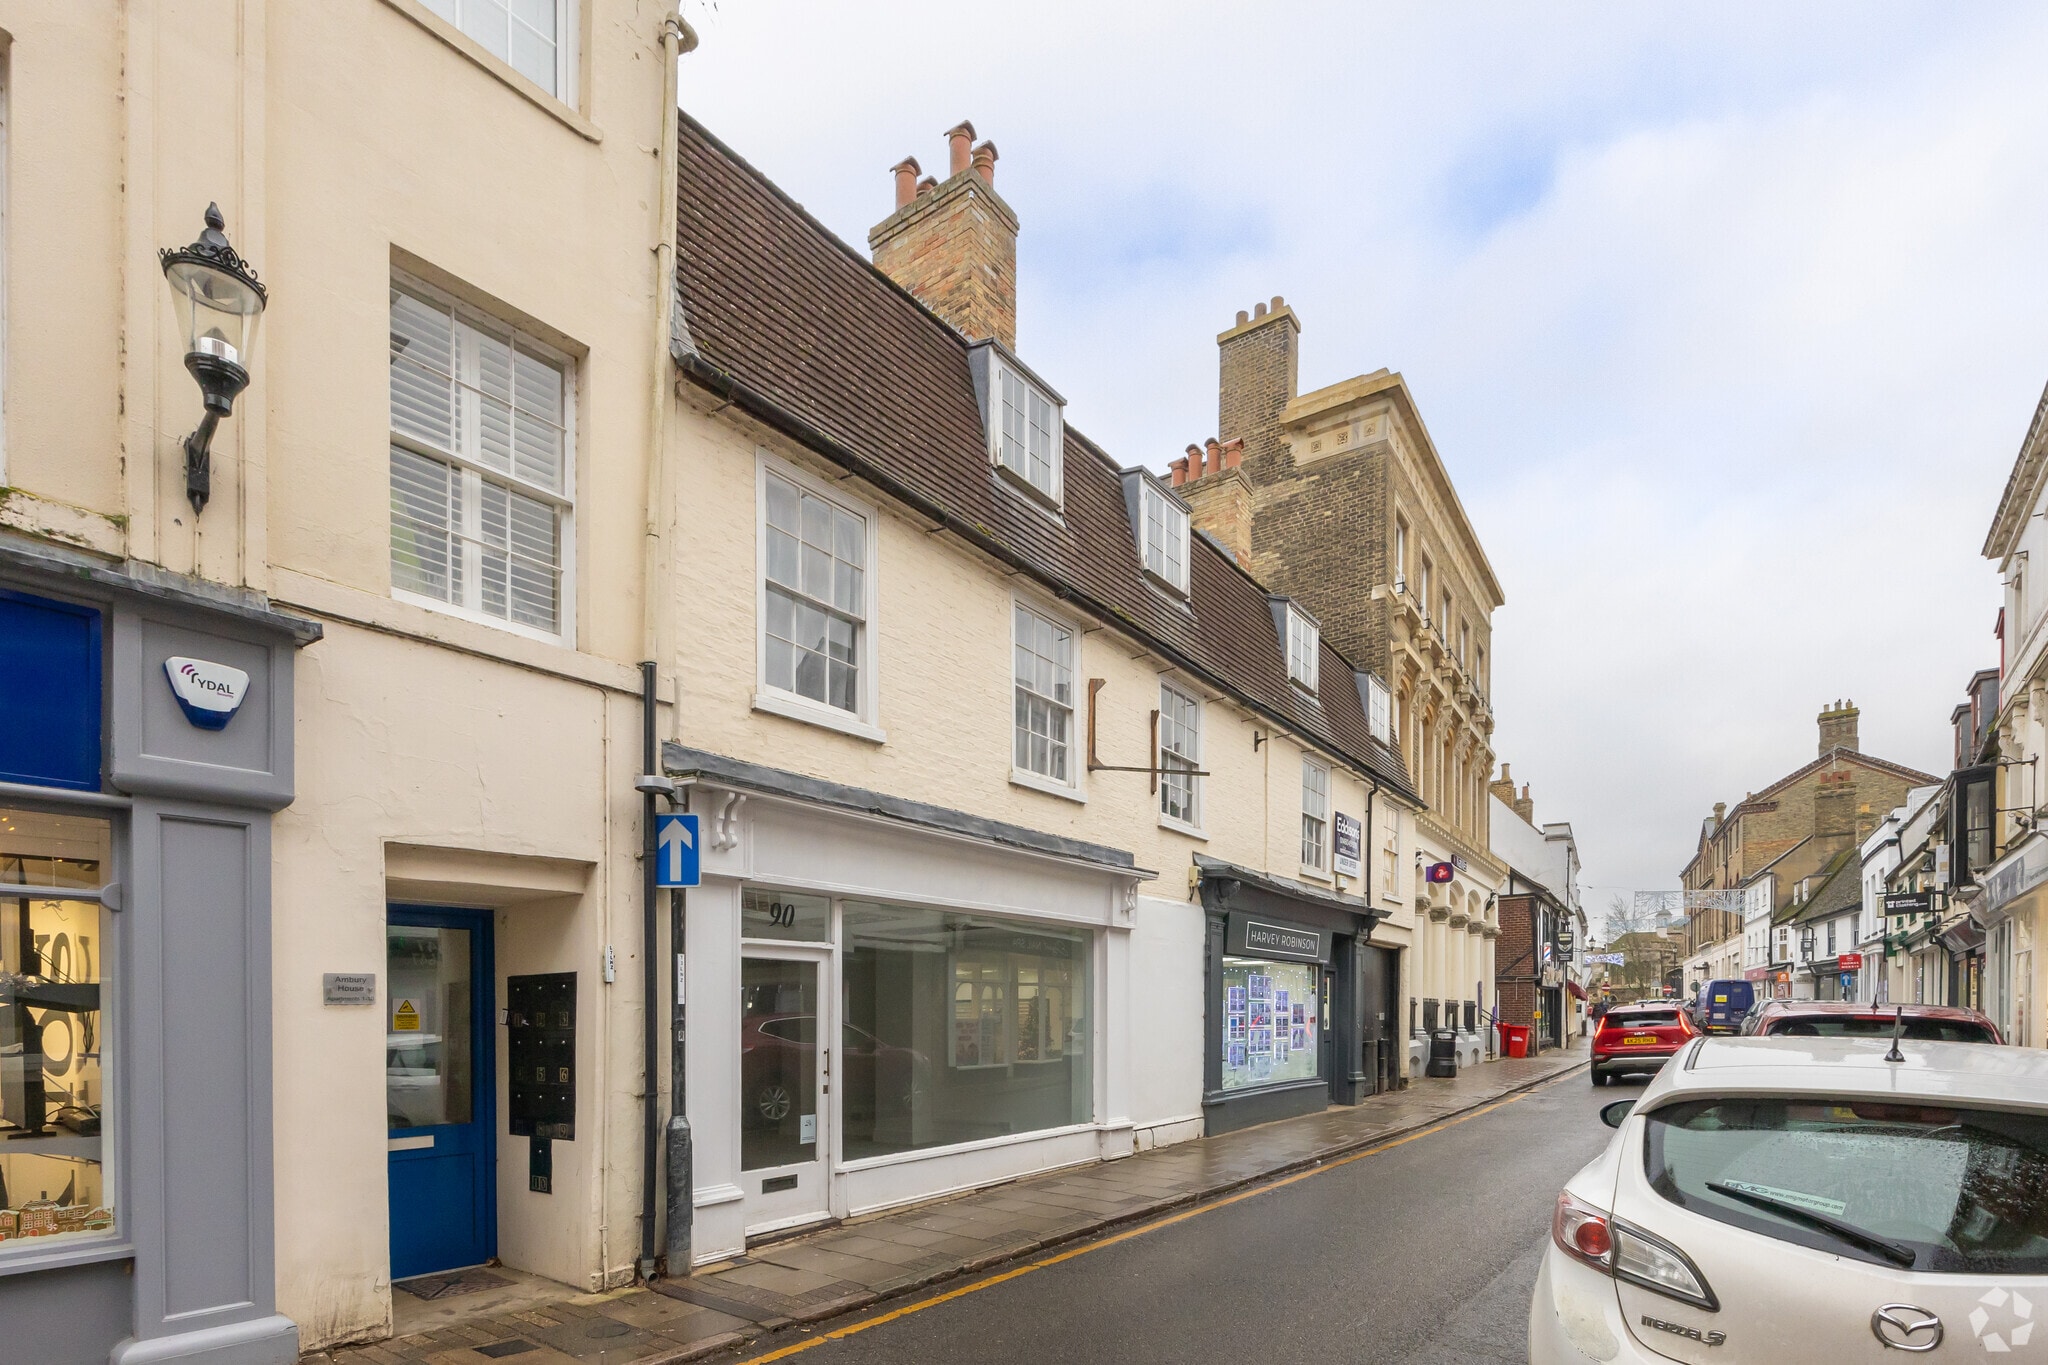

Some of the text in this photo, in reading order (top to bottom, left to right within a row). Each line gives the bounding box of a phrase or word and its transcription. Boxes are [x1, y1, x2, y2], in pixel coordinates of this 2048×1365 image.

[1337, 816, 1360, 840] Eddisons
[769, 903, 795, 928] 90
[1251, 930, 1316, 950] HARVEY ROBINSON
[335, 976, 367, 985] Ambury
[532, 1176, 547, 1190] 10
